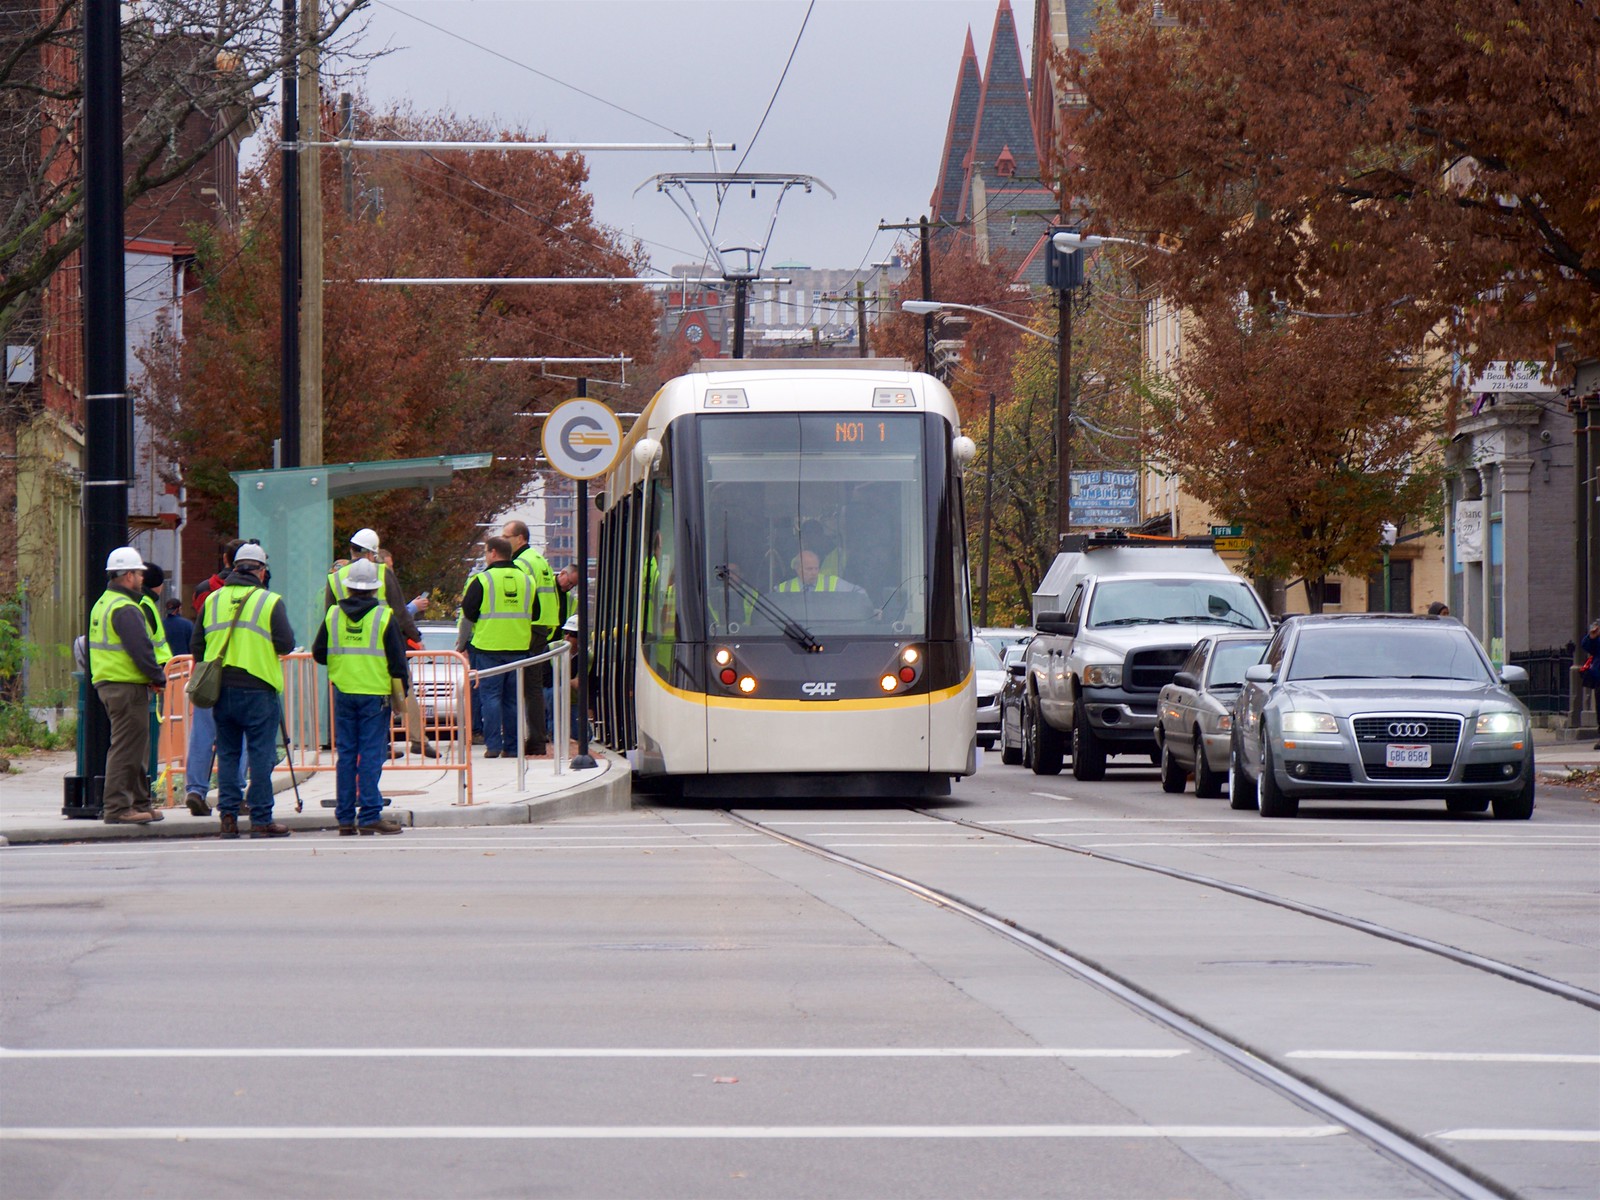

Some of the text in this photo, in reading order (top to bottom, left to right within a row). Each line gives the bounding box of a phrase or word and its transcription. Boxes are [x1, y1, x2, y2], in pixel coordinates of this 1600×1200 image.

[1491, 381, 1529, 390] 721-9428
[1102, 471, 1134, 486] STATES
[1214, 526, 1232, 535] TIFFIN
[801, 682, 837, 696] CAF
[1407, 750, 1429, 763] 8584
